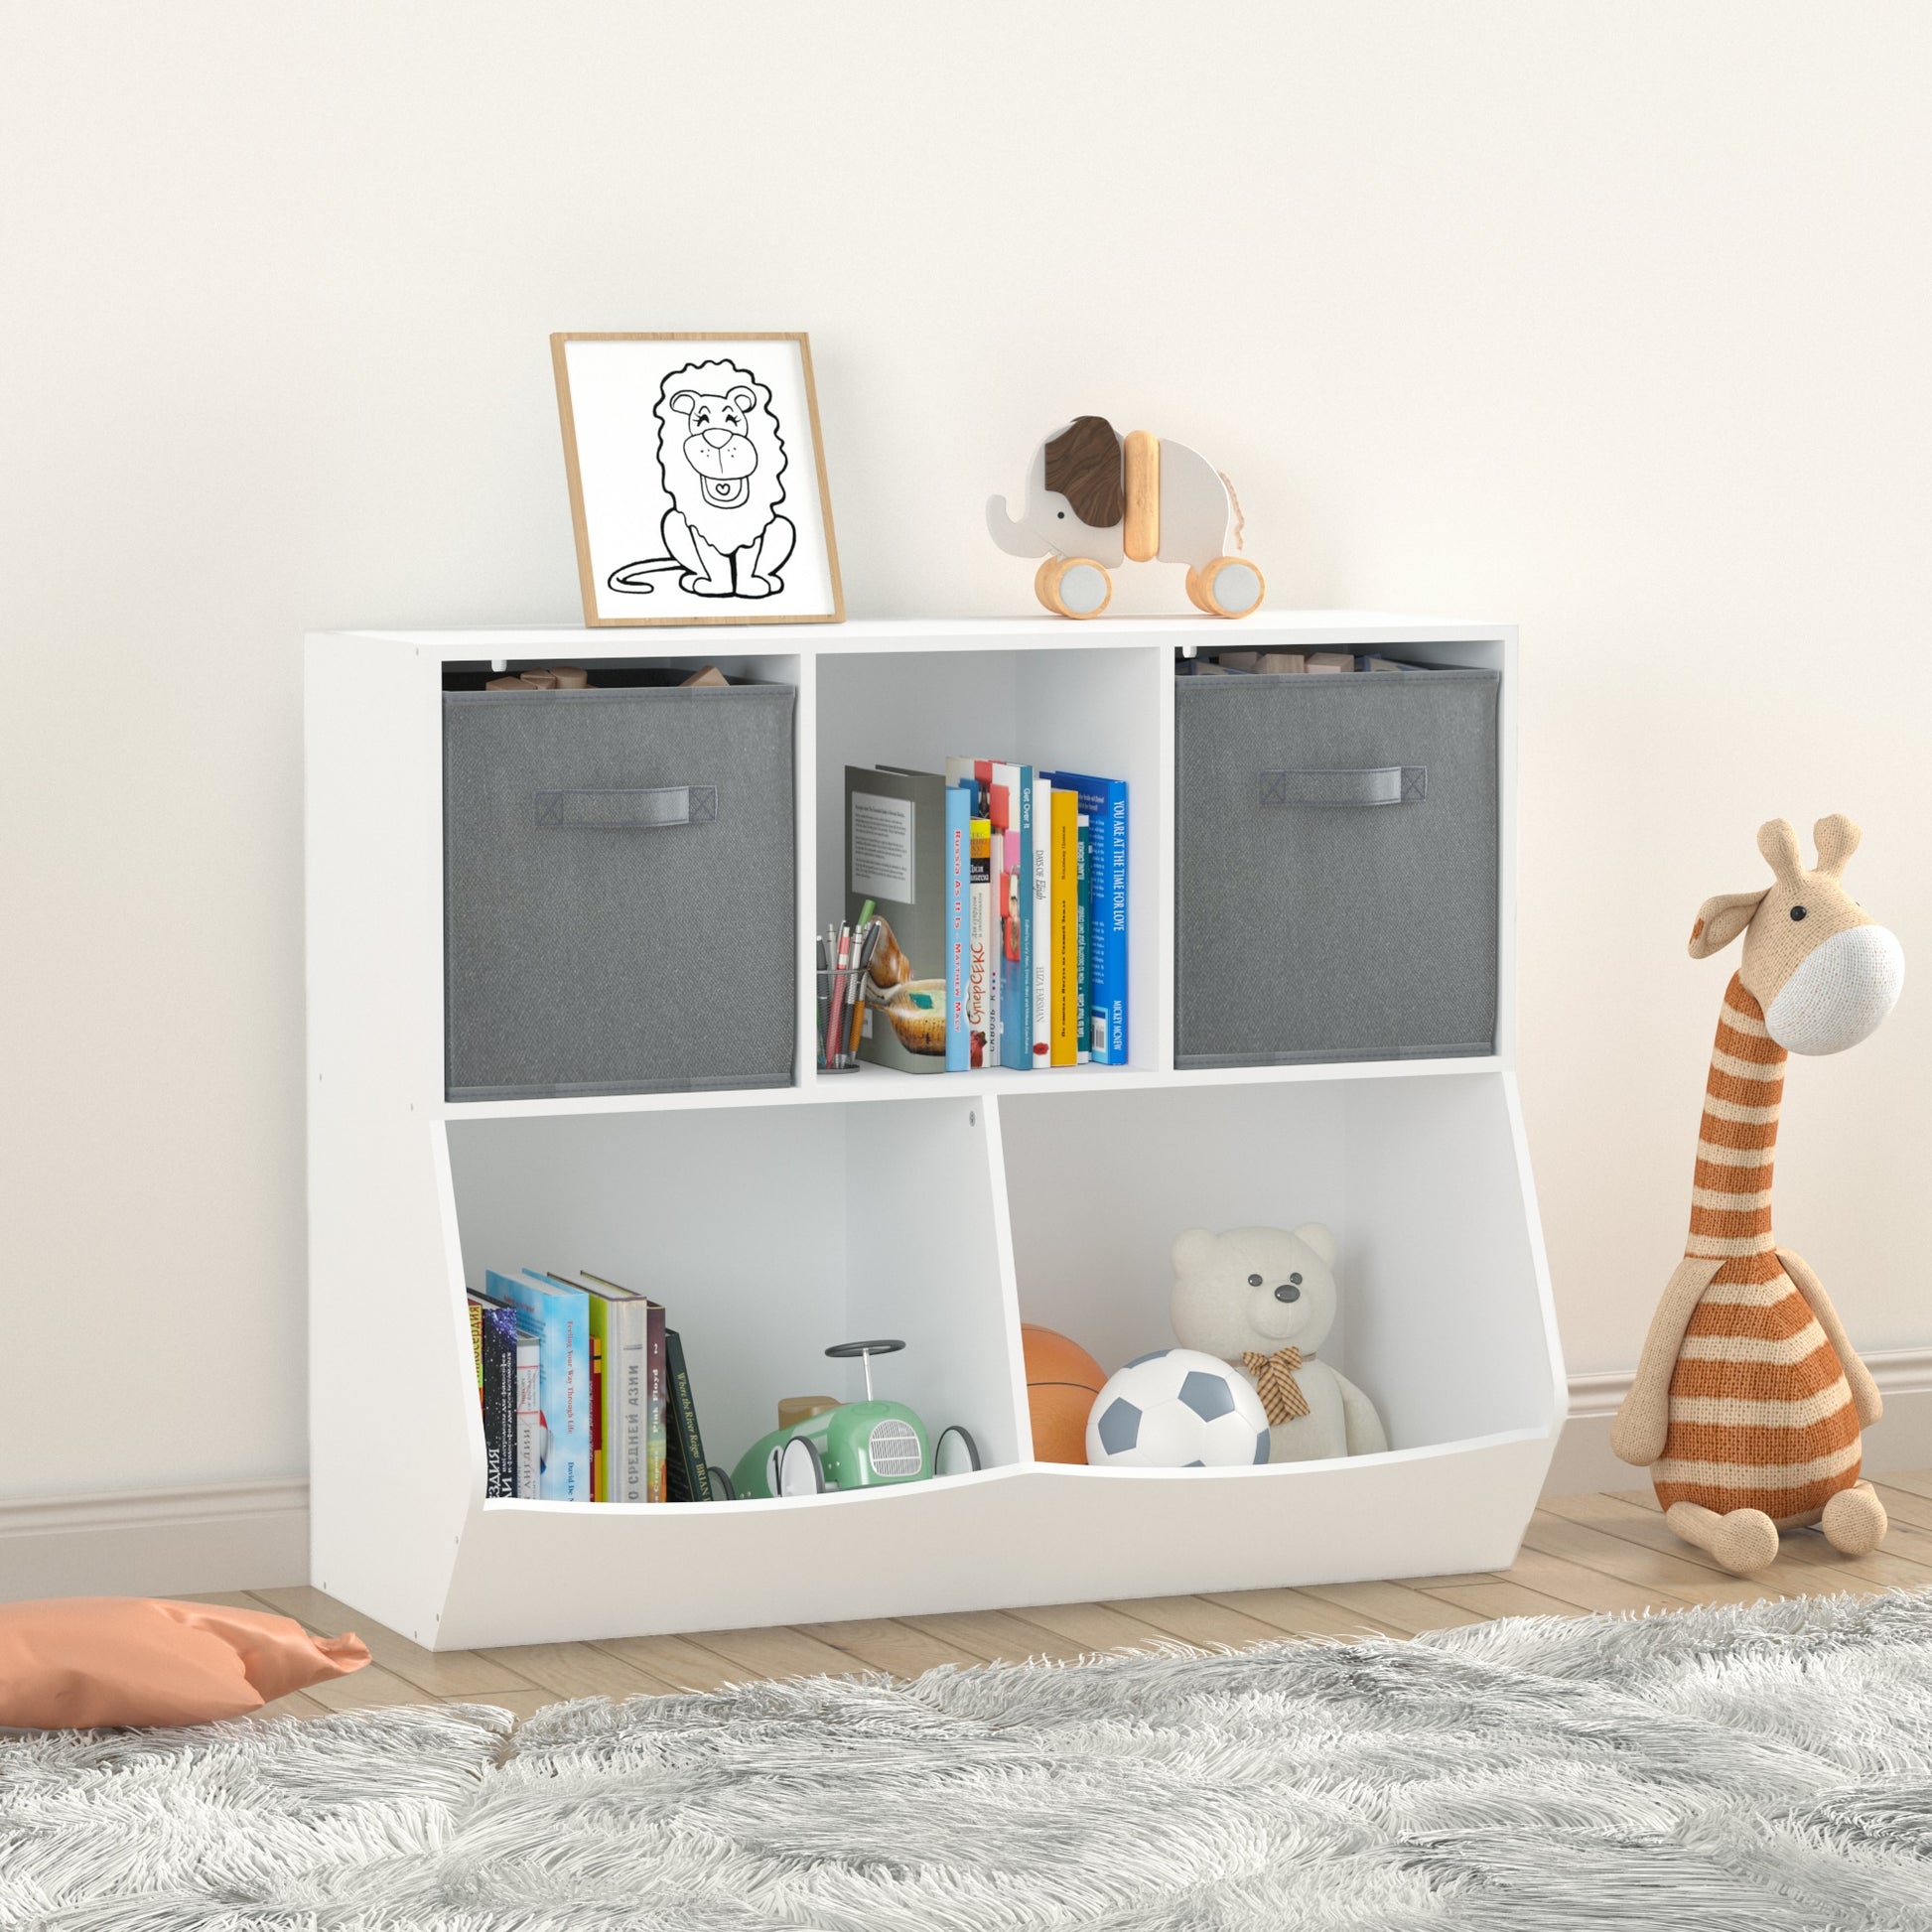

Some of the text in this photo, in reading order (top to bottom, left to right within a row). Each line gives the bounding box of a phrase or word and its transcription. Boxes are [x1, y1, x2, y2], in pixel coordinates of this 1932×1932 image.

[953, 829, 962, 875] Russia
[1033, 850, 1046, 900] DAYS OF Elijah
[1113, 800, 1125, 931] YOU ARE AT THE TIME FOR LOVE
[953, 880, 962, 897] As
[953, 900, 962, 911] It
[953, 916, 962, 929] Is
[970, 942, 986, 1026] СуперСЕКС
[1035, 966, 1044, 986] ELIZA
[1113, 1000, 1123, 1050] MICKEY MCNEW
[628, 1365, 639, 1406] АЗИИ
[677, 1372, 687, 1397] Where
[682, 1398, 691, 1410] the
[684, 1411, 695, 1433] River
[625, 1414, 639, 1484] СРЕДНЕЙ
[690, 1435, 700, 1458] Reigns
[568, 1484, 574, 1495] De
[696, 1462, 708, 1495] BRIAN
